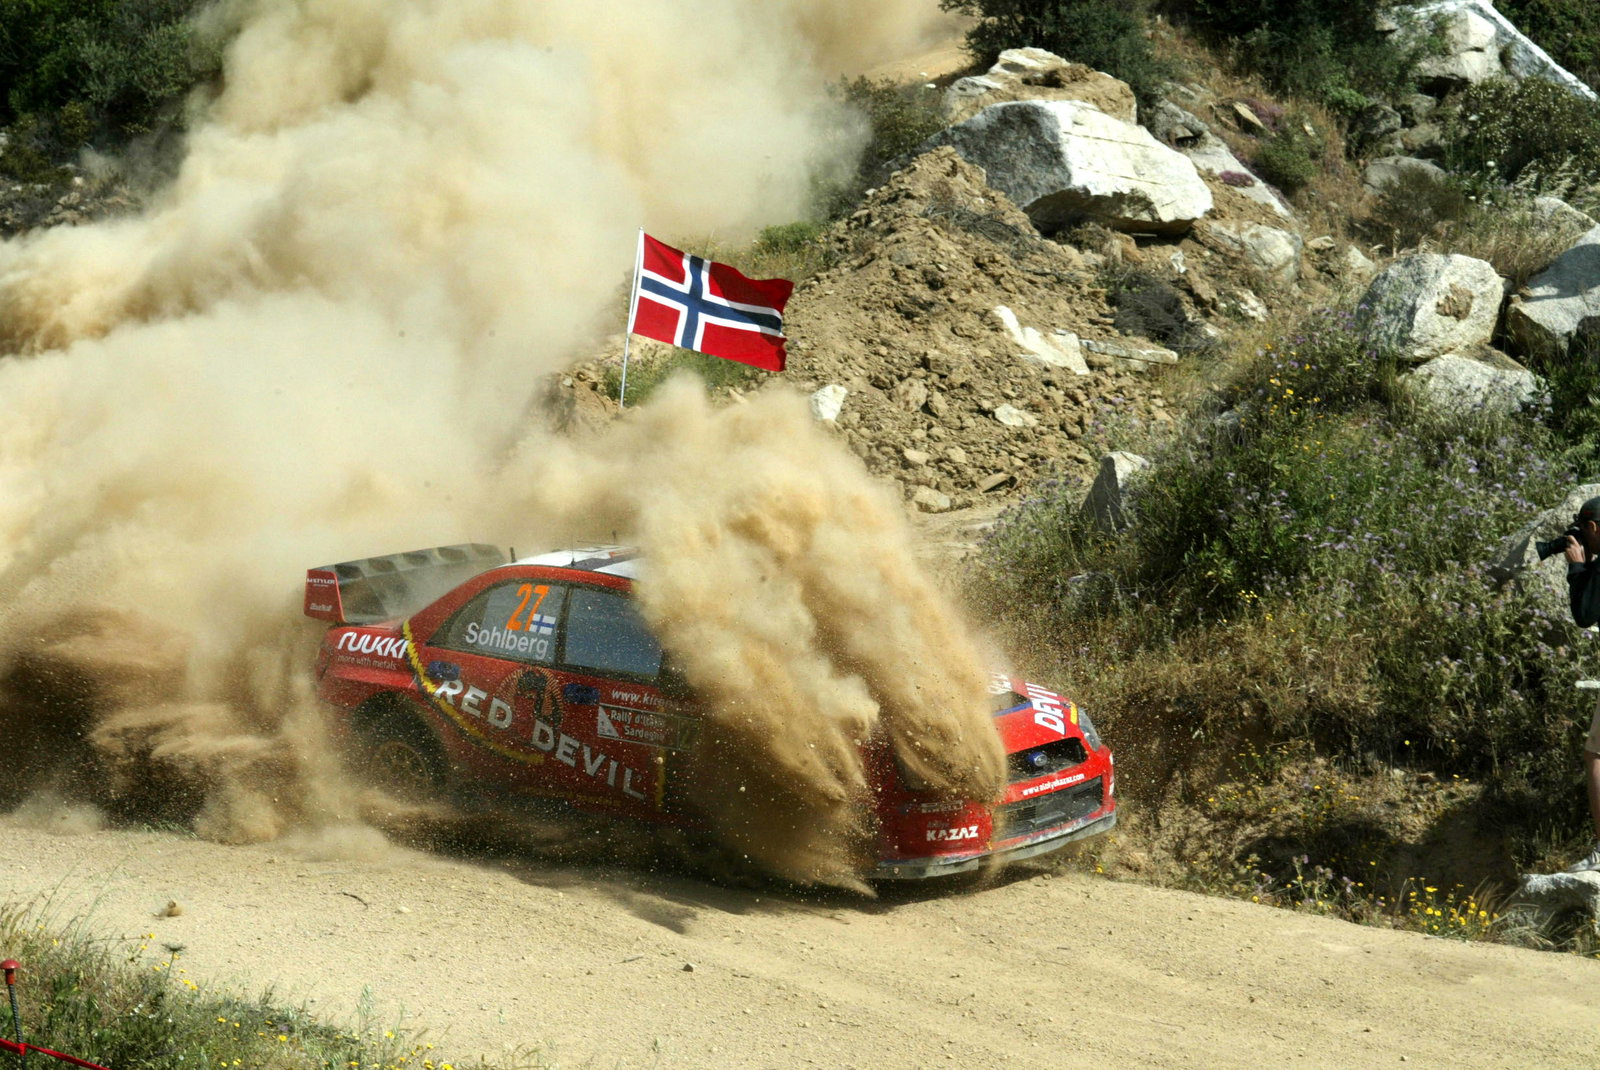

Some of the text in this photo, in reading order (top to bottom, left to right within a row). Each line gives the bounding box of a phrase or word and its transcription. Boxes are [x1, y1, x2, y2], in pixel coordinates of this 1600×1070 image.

[506, 583, 550, 632] 27
[465, 622, 549, 660] Sohlberg
[610, 709, 631, 724] Rally
[434, 679, 645, 800] RED DEVIL
[926, 825, 979, 841] KAZAZ
